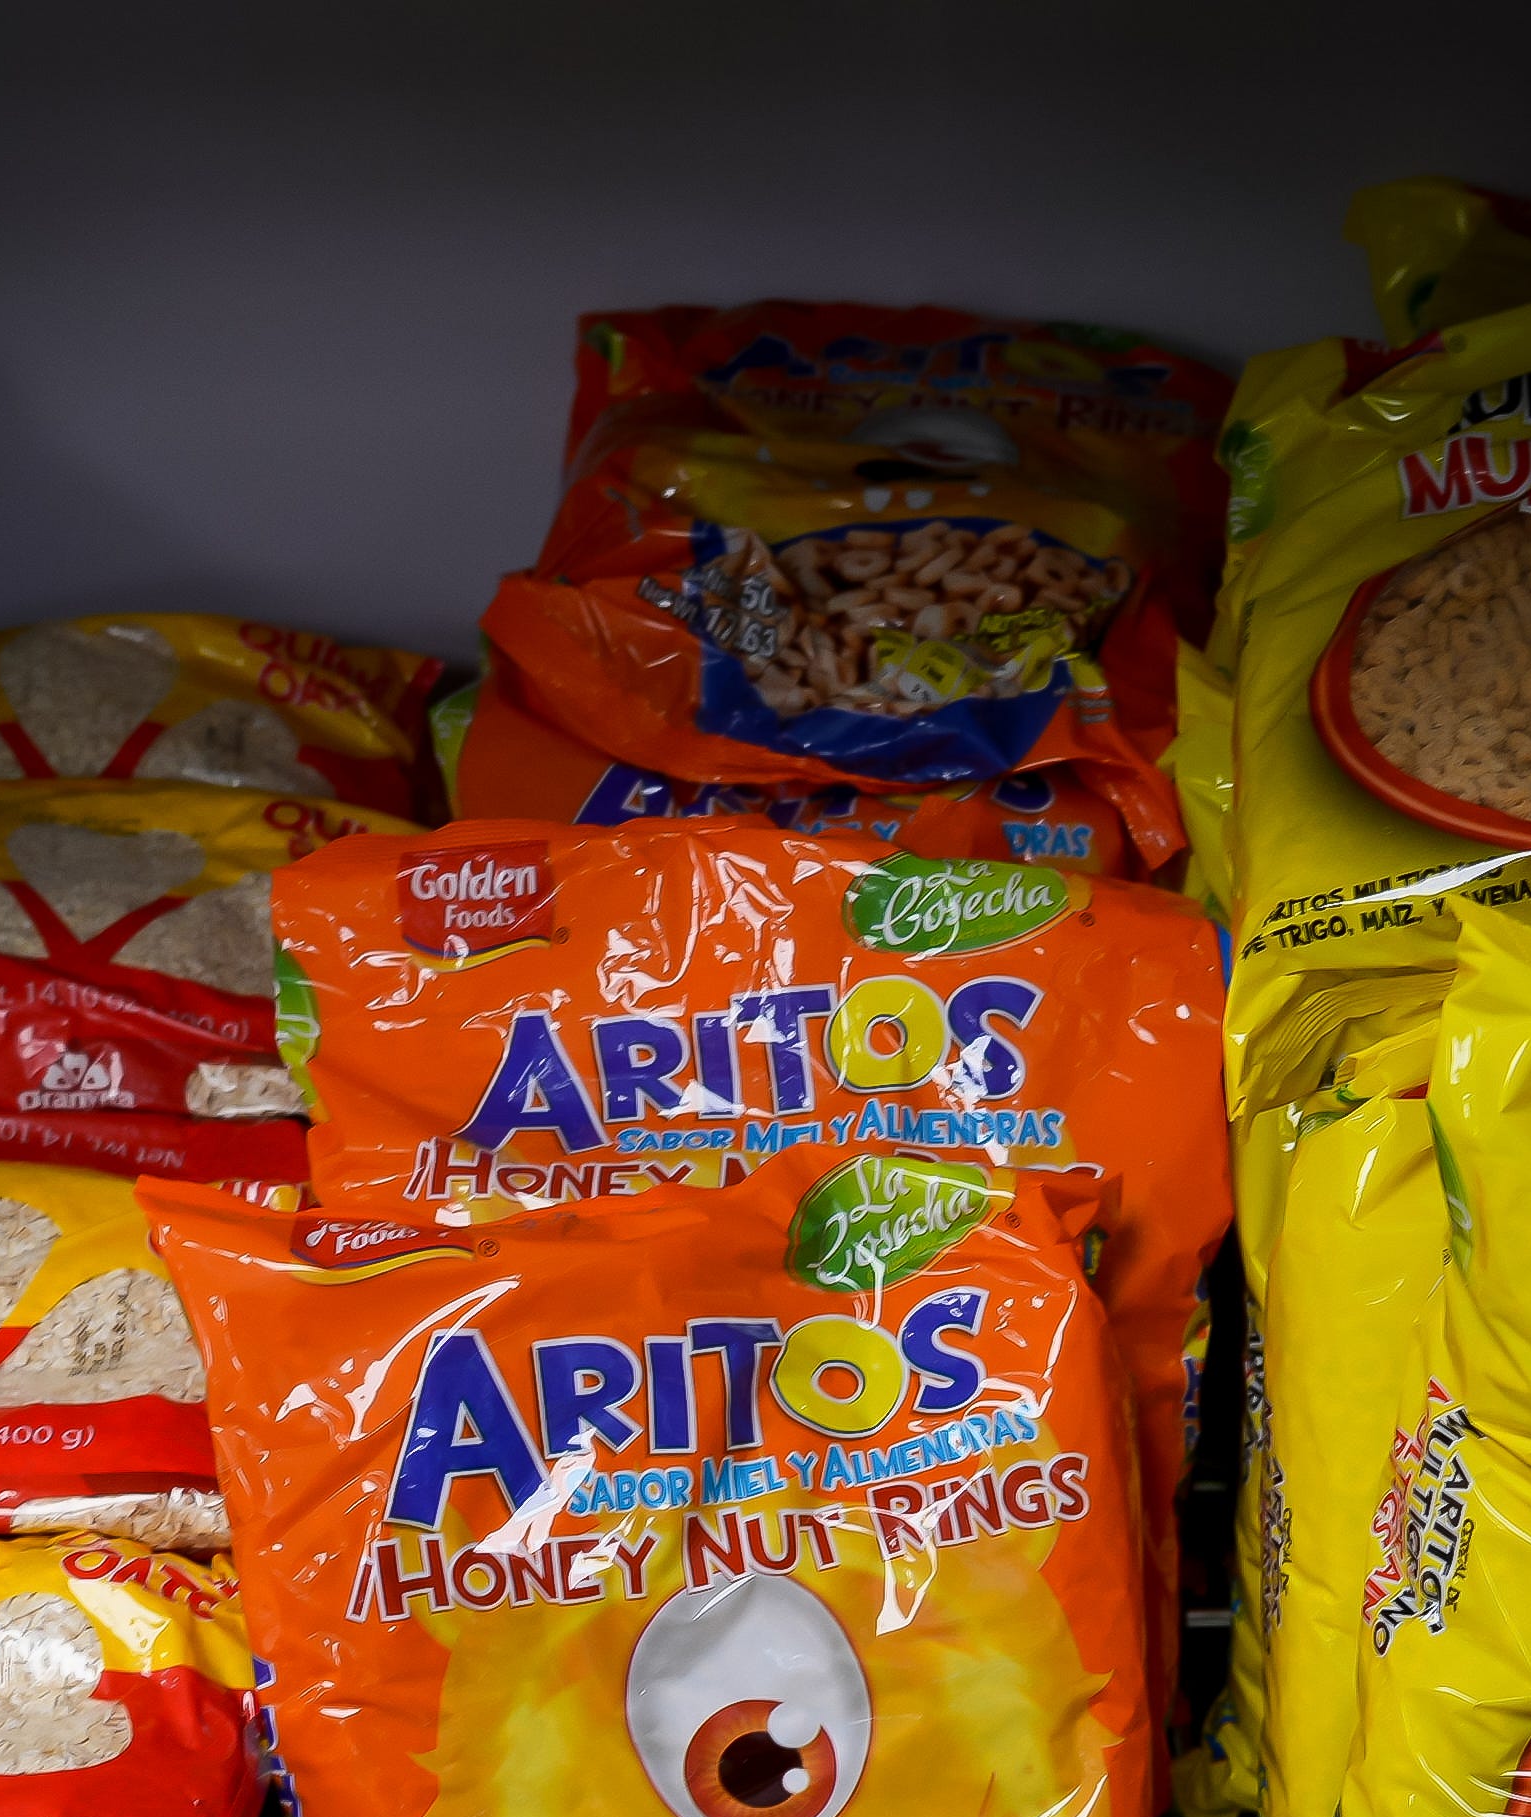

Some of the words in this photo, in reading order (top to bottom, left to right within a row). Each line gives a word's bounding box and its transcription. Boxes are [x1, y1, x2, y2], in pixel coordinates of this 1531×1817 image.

[410, 859, 538, 900] Golden
[924, 859, 995, 887] La
[444, 902, 517, 930] Foods
[870, 873, 1055, 946] Cosecha
[1270, 915, 1353, 949] TRIGO,
[1432, 898, 1446, 917] Y
[455, 973, 1046, 1155] ARITOS
[614, 1126, 730, 1154] SABOR
[855, 1098, 1066, 1151] ALMENDRAS
[848, 1156, 911, 1224] La
[806, 1175, 974, 1285] Cosecha
[382, 1283, 988, 1534] ARITOS
[566, 1467, 695, 1516] SABOR
[699, 1456, 786, 1507] MIEL
[789, 1450, 819, 1491] Y
[821, 1400, 1042, 1493] ALMENDRAS
[683, 1505, 843, 1594] NUT
[865, 1452, 1091, 1560] RINGS
